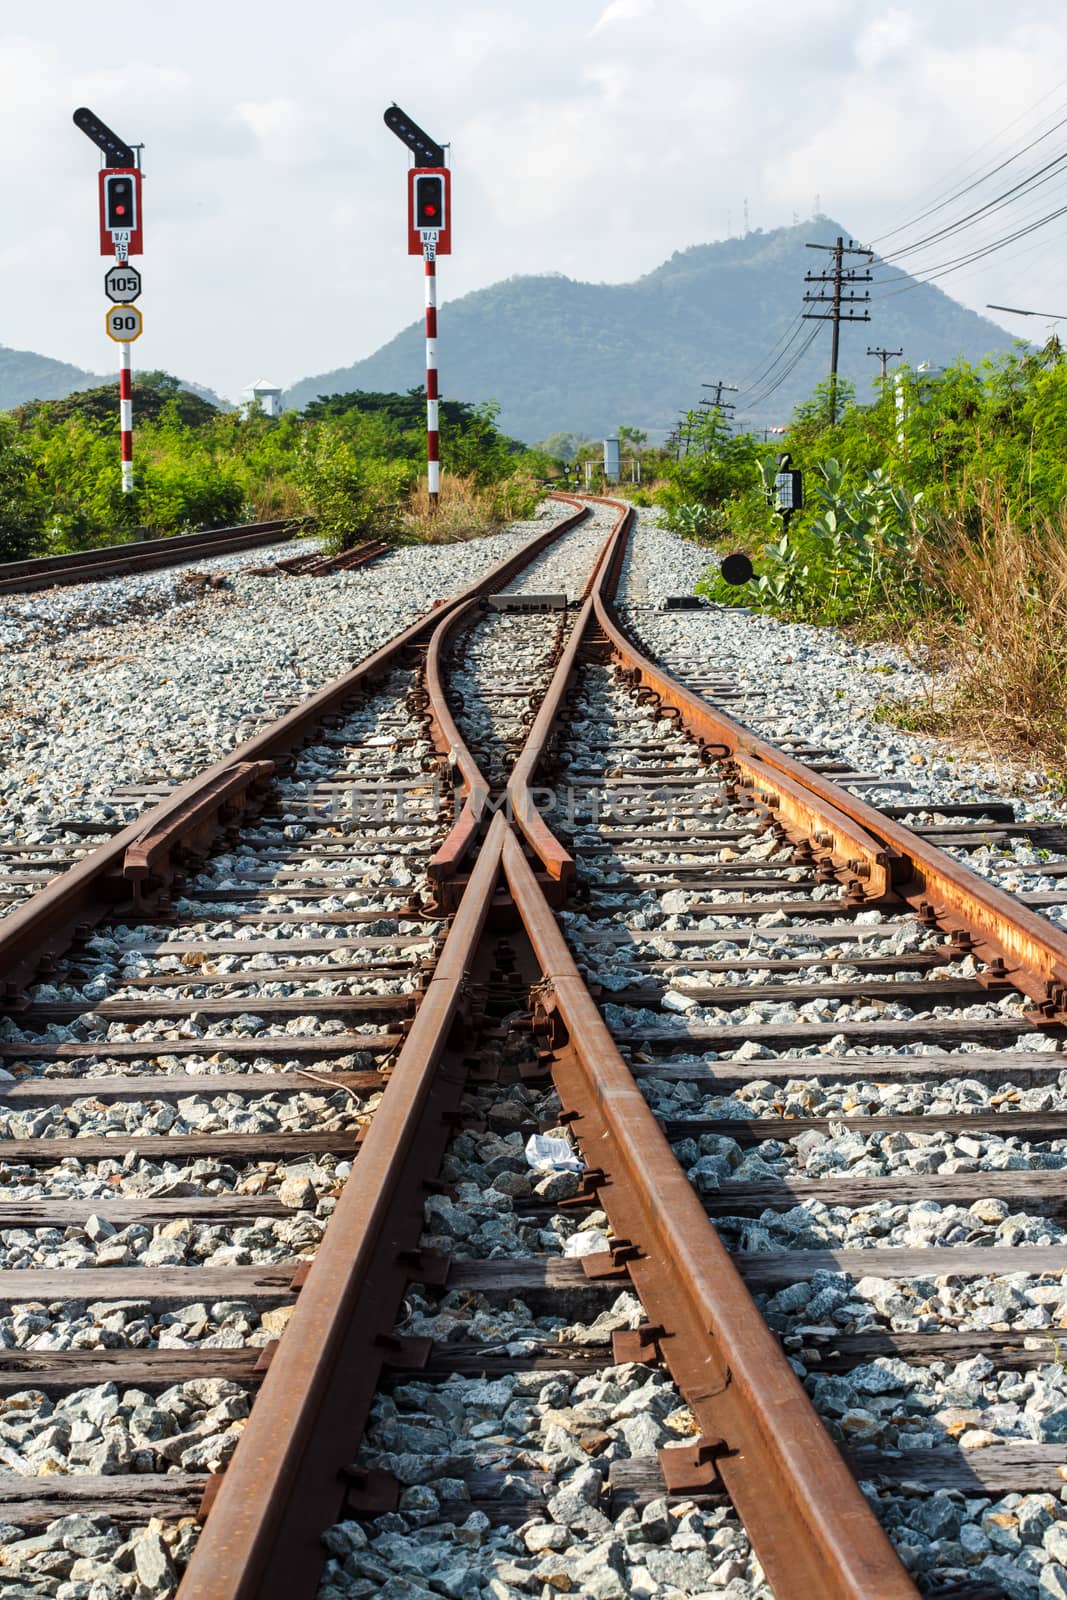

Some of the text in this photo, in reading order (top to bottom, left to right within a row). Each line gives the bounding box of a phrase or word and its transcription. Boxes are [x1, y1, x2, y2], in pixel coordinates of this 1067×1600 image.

[118, 252, 126, 260] 17
[109, 278, 138, 292] 105
[112, 316, 136, 330] 90
